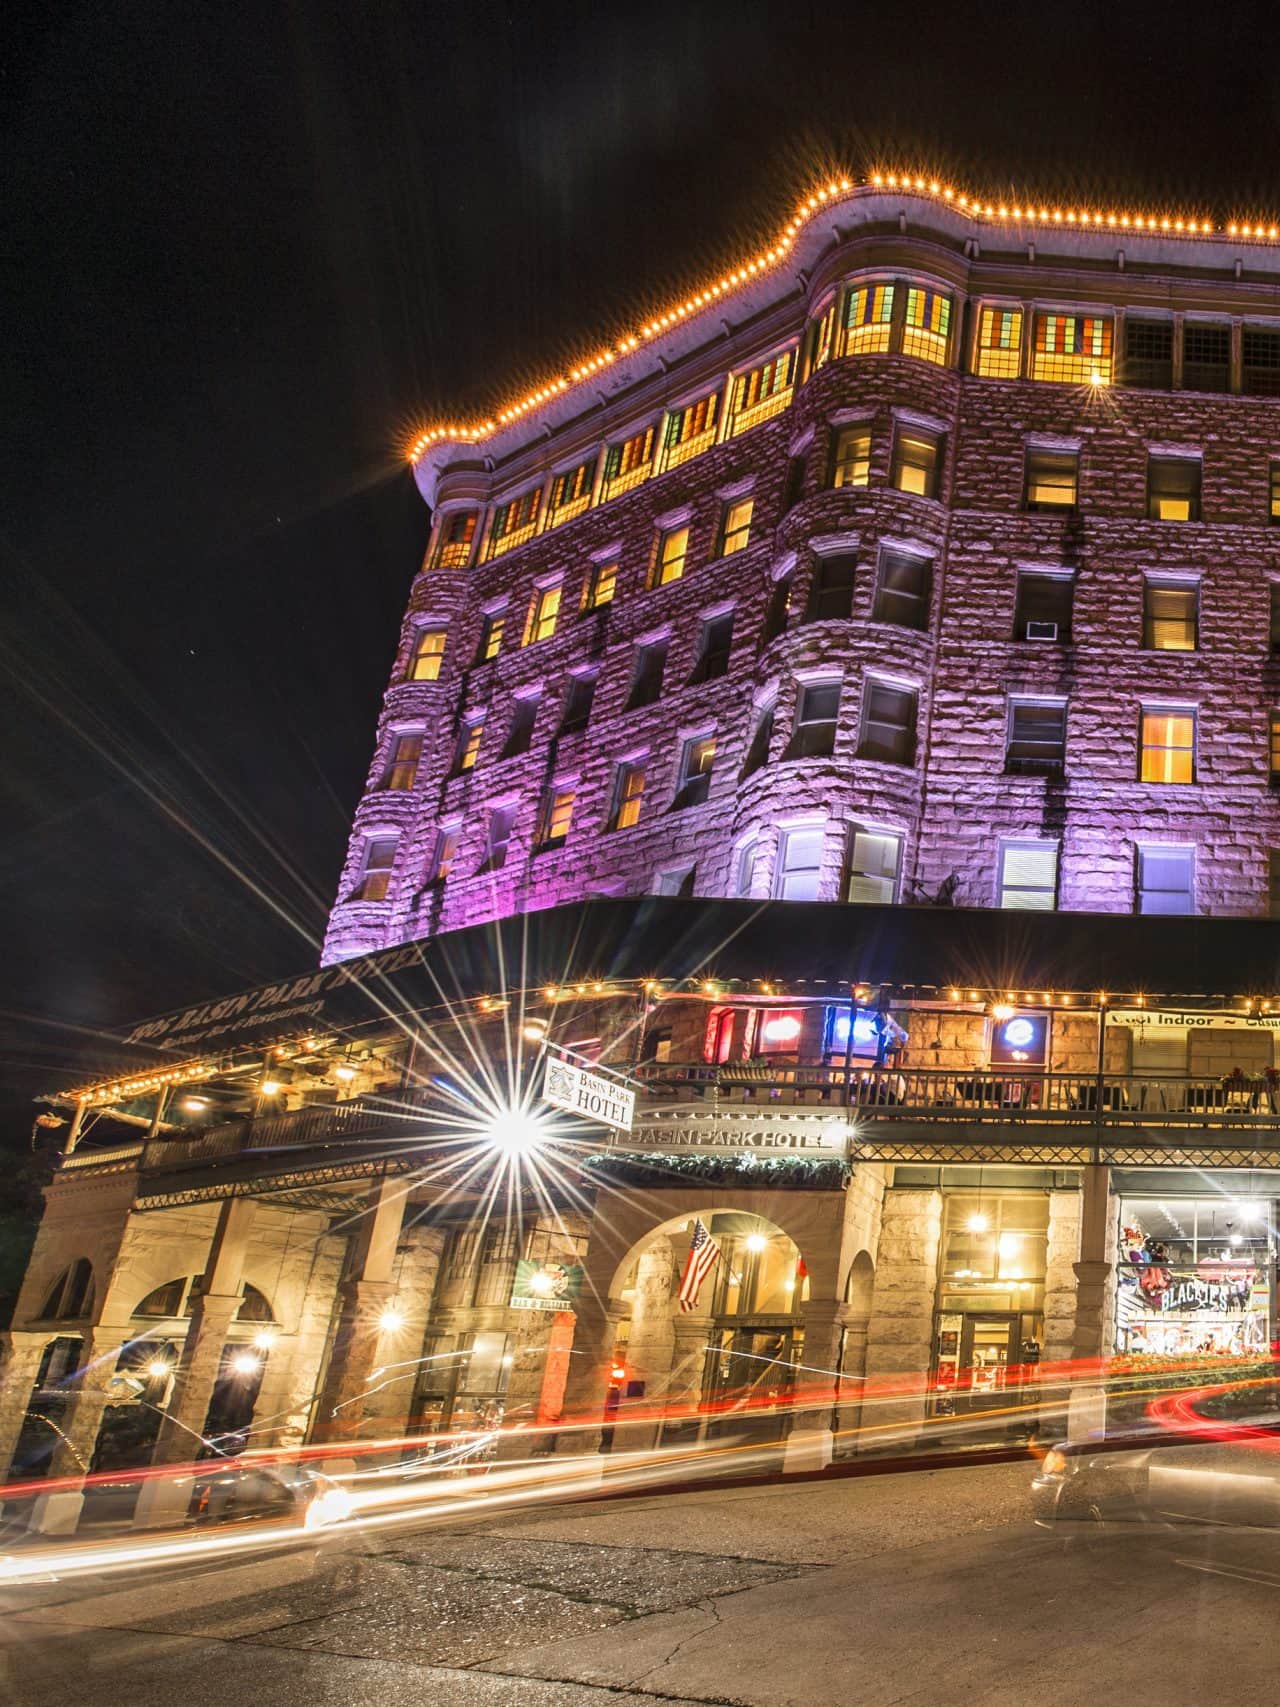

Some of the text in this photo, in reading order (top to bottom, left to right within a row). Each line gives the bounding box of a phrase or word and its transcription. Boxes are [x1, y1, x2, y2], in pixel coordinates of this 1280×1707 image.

[249, 971, 334, 1011] PARK
[1159, 1014, 1214, 1026] Indoor
[579, 1073, 631, 1104] BASIN PARK
[577, 1089, 629, 1125] HOTEL
[628, 1128, 694, 1145] BASIN
[698, 1131, 755, 1146] PARK
